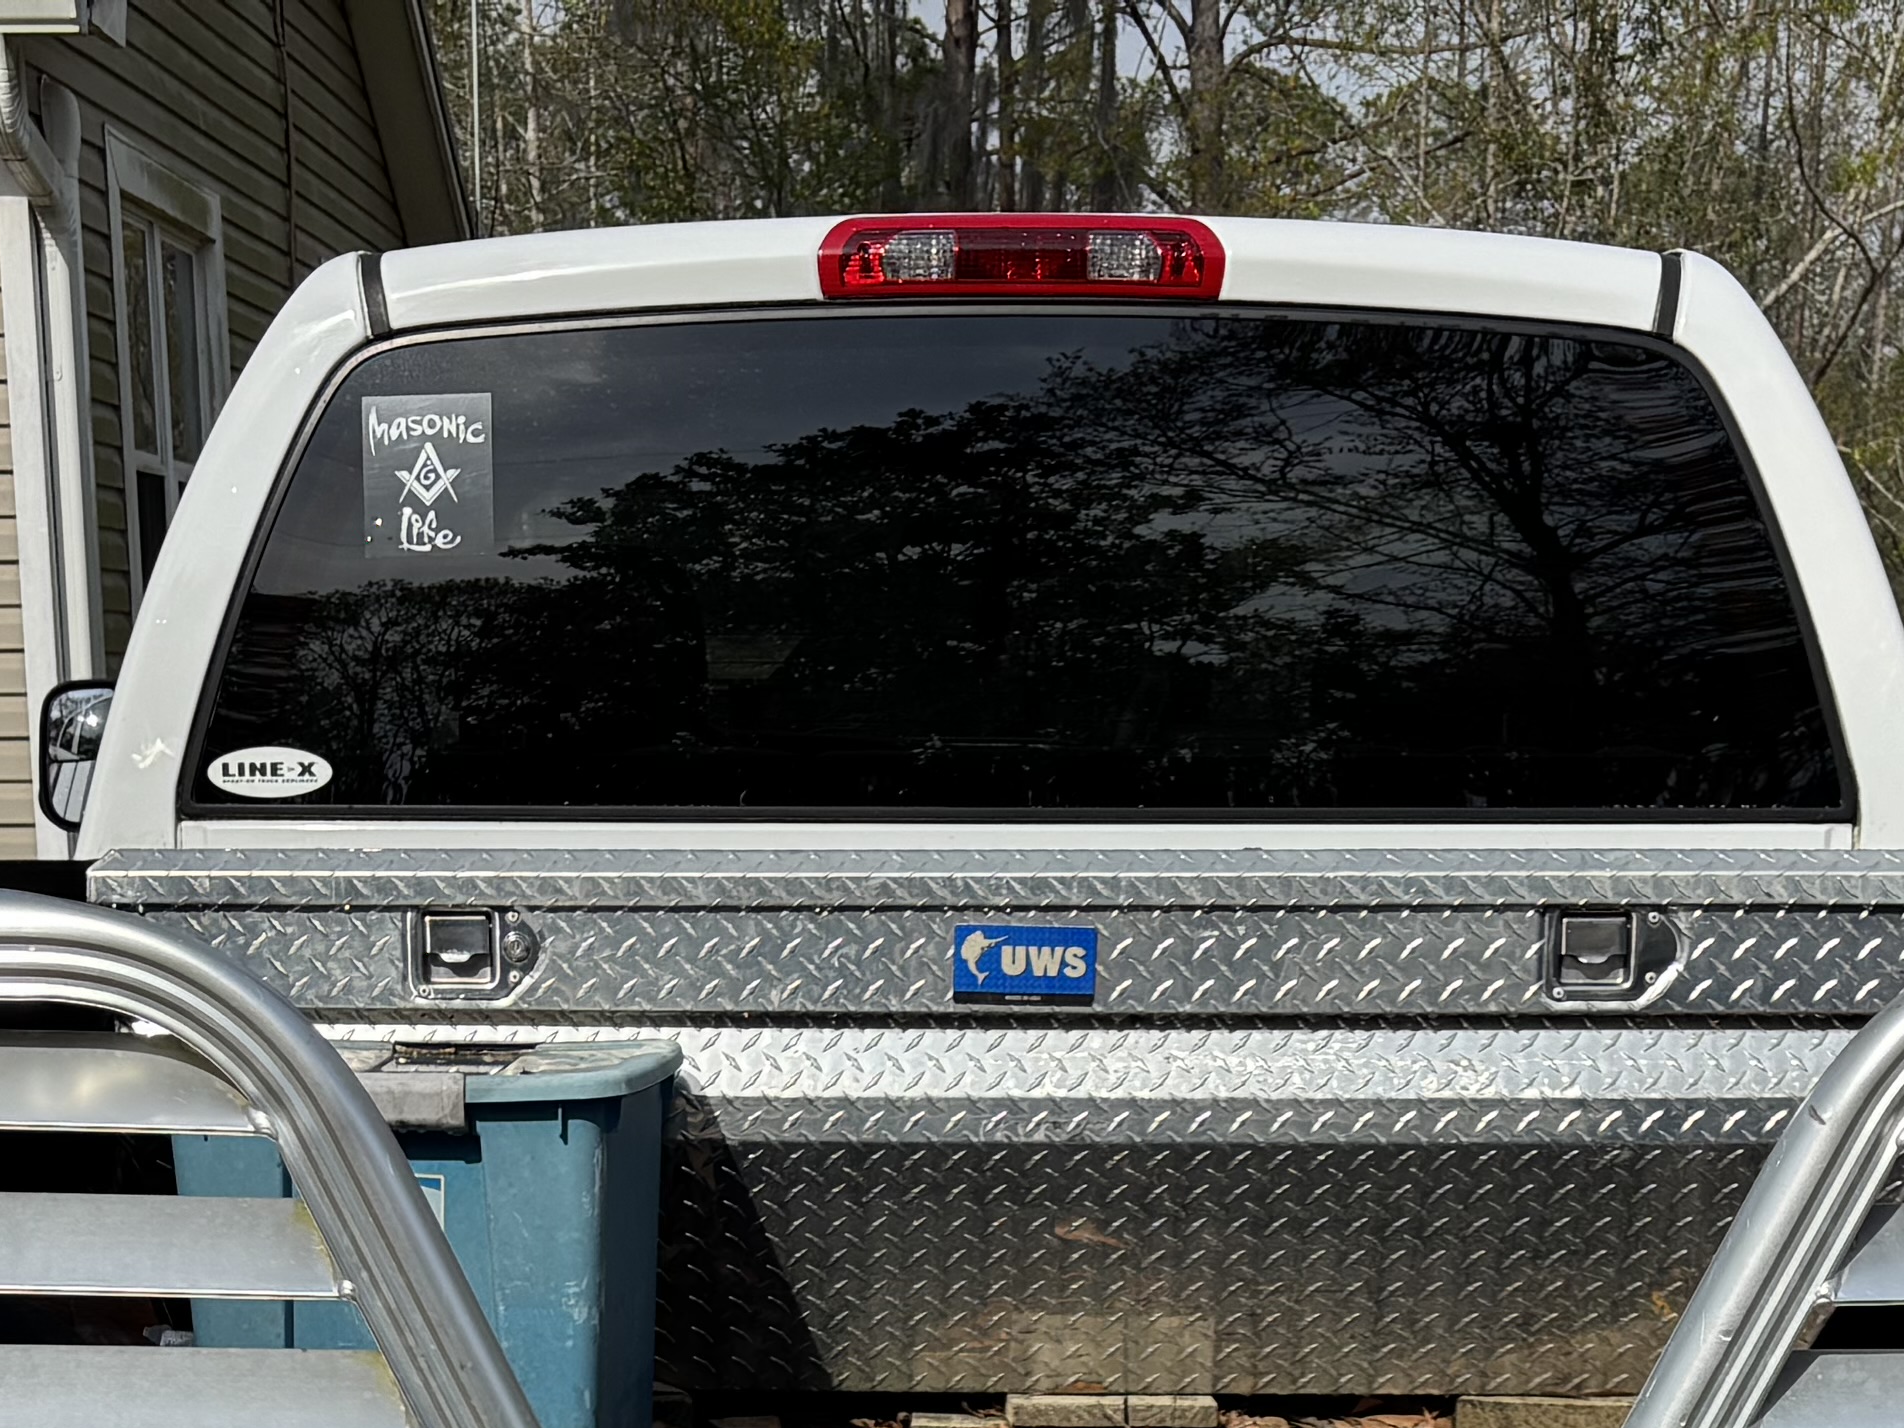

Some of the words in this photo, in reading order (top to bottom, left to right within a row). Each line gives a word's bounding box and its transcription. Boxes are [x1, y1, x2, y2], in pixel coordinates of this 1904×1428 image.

[398, 507, 462, 552] Life
[221, 762, 318, 777] LINE-X
[1001, 945, 1087, 978] UWS
